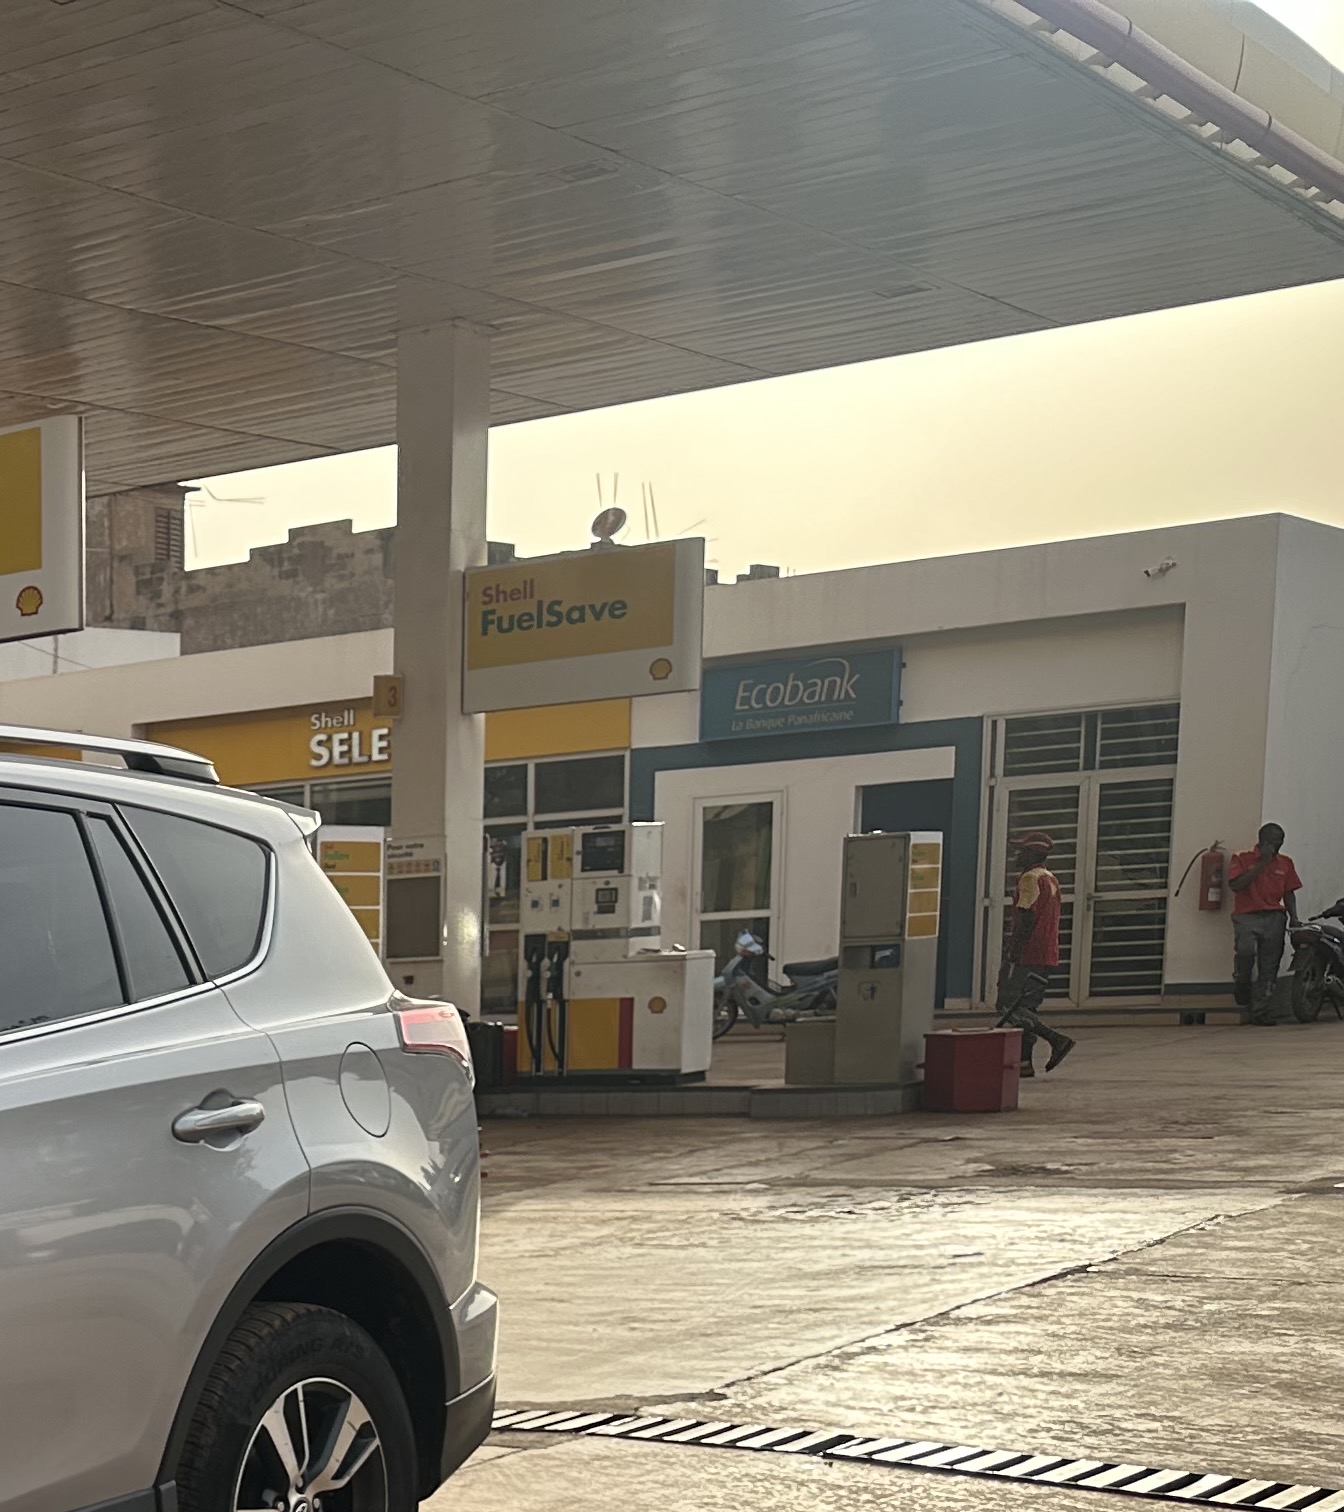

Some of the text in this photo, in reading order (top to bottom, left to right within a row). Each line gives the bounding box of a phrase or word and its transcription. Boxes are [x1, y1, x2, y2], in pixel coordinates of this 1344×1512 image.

[481, 578, 535, 606] Shell
[480, 599, 628, 637] FuelSave
[387, 685, 398, 708] 3
[735, 658, 860, 710] Ecobank
[310, 709, 354, 730] Shell
[731, 710, 854, 732] La Banque Panafricaine
